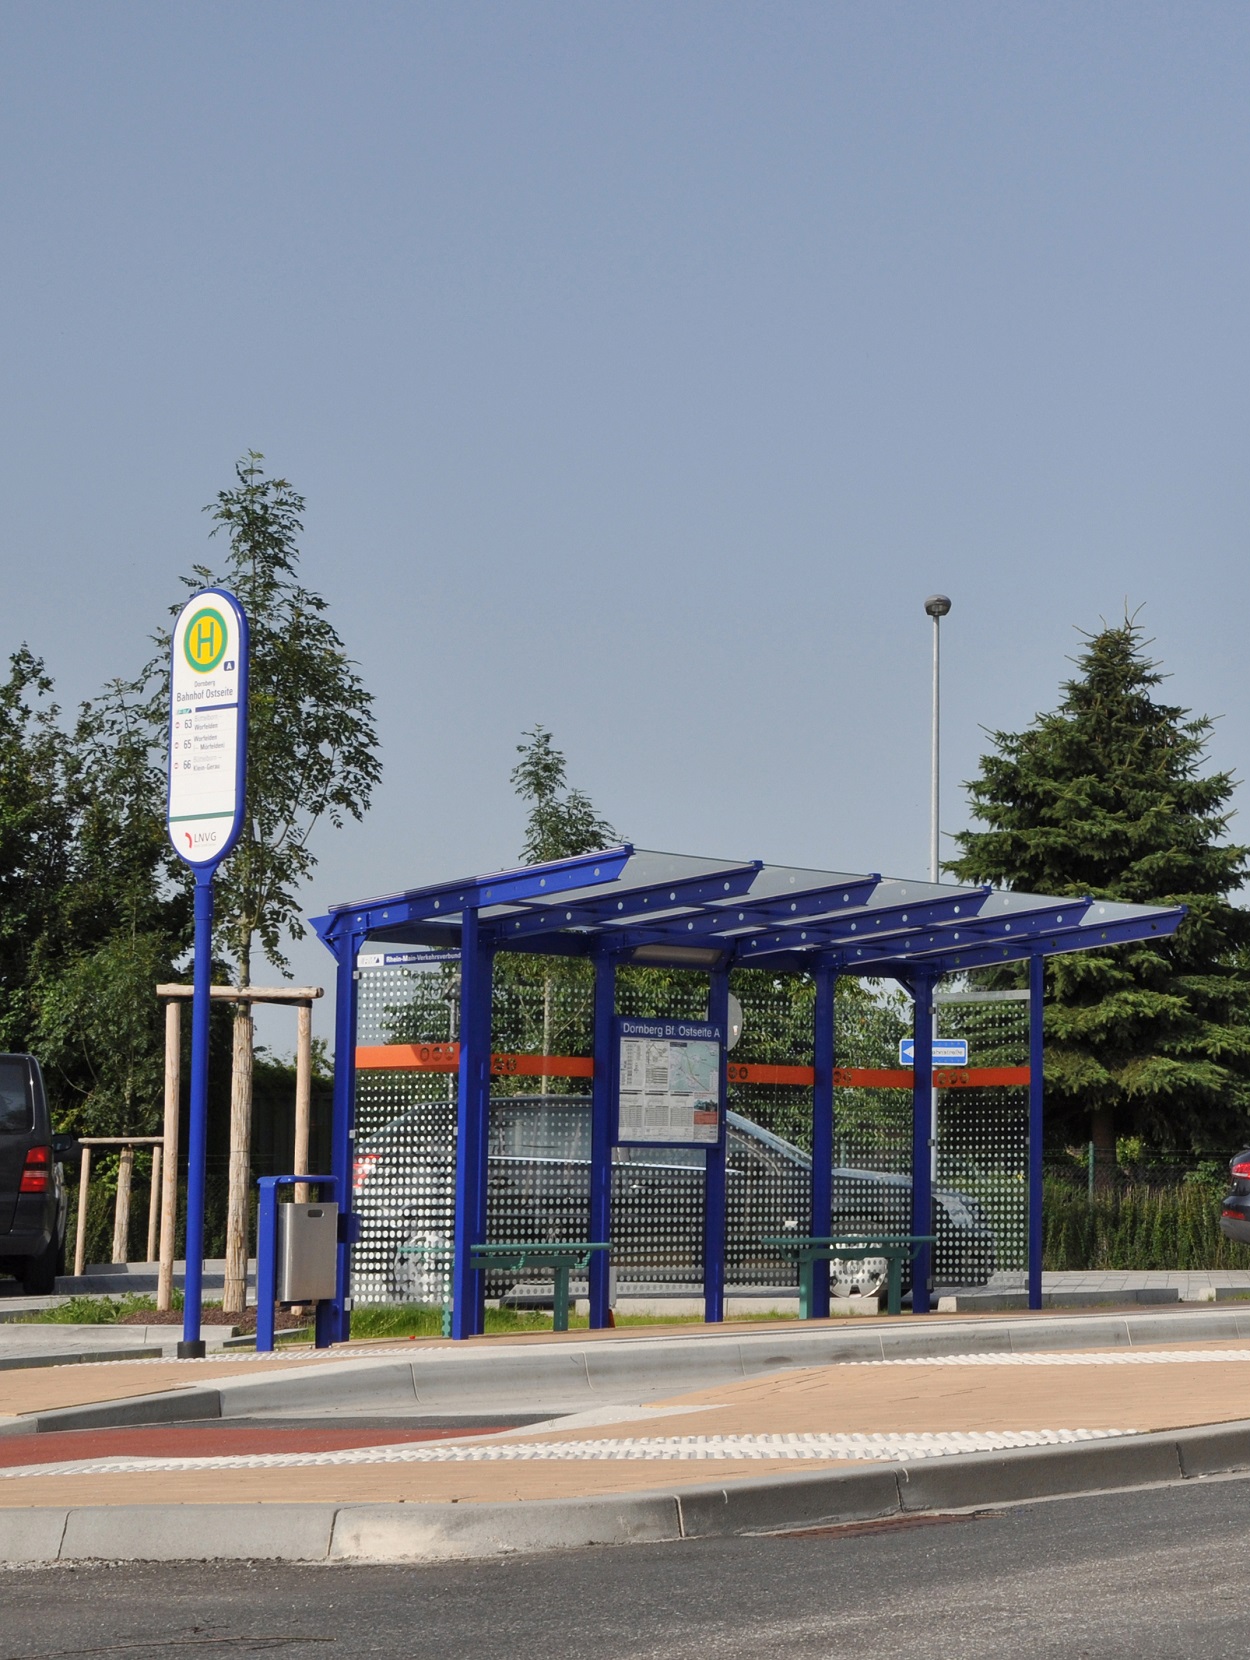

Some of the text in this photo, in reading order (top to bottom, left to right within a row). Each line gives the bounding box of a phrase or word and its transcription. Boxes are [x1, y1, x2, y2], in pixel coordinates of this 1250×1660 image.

[197, 621, 215, 659] H
[226, 661, 233, 670] A
[176, 686, 234, 703] Bahnhof Ostseite
[184, 718, 193, 729] 63
[183, 739, 192, 750] 65
[182, 760, 192, 770] 66
[194, 831, 217, 843] LNVG
[623, 1022, 721, 1038] Dornberg Bf. Ostseite A
